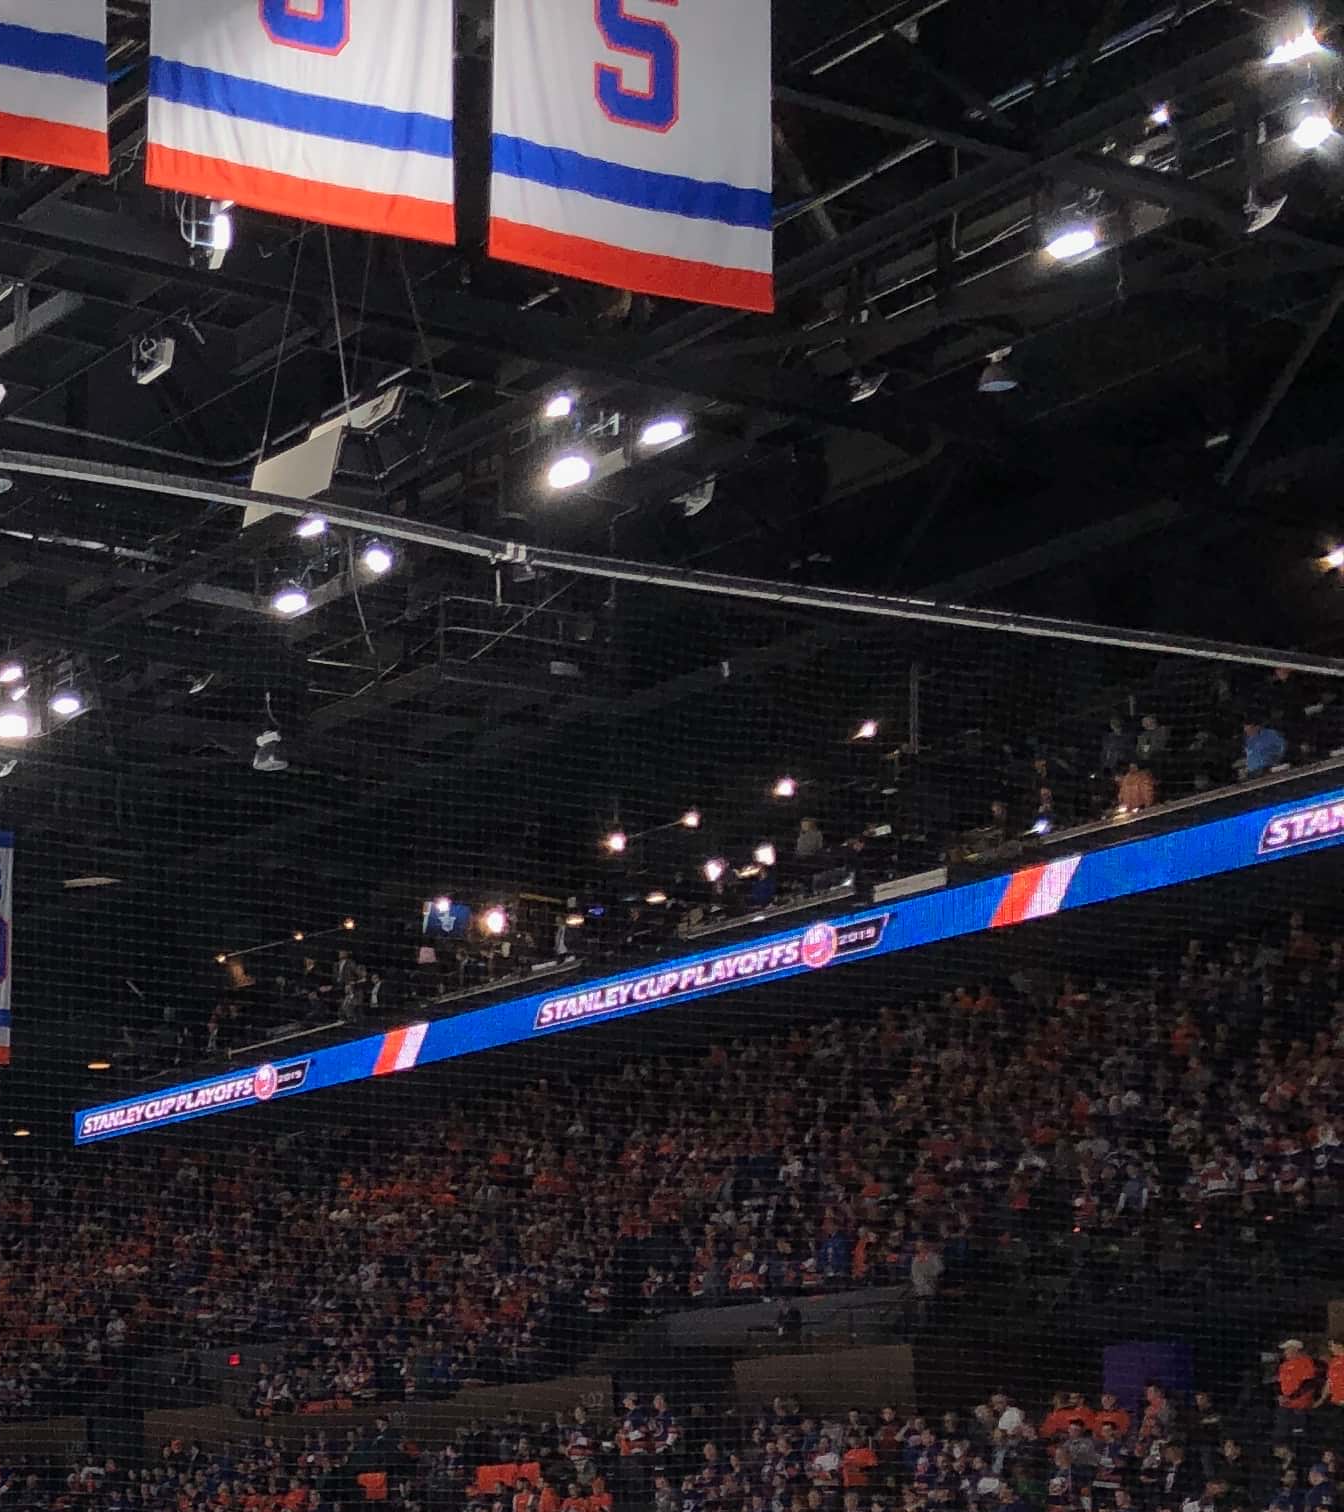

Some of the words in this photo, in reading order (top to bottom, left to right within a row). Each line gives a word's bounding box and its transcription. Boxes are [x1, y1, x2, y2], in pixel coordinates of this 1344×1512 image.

[540, 984, 634, 1024] STANLEY
[631, 974, 682, 1002] CUP
[679, 940, 801, 992] PLAYOFFS
[838, 925, 875, 945] 2019
[82, 1107, 148, 1135] STANLEY
[144, 1099, 176, 1118] CUP
[173, 1078, 254, 1111] PLAYOFFS
